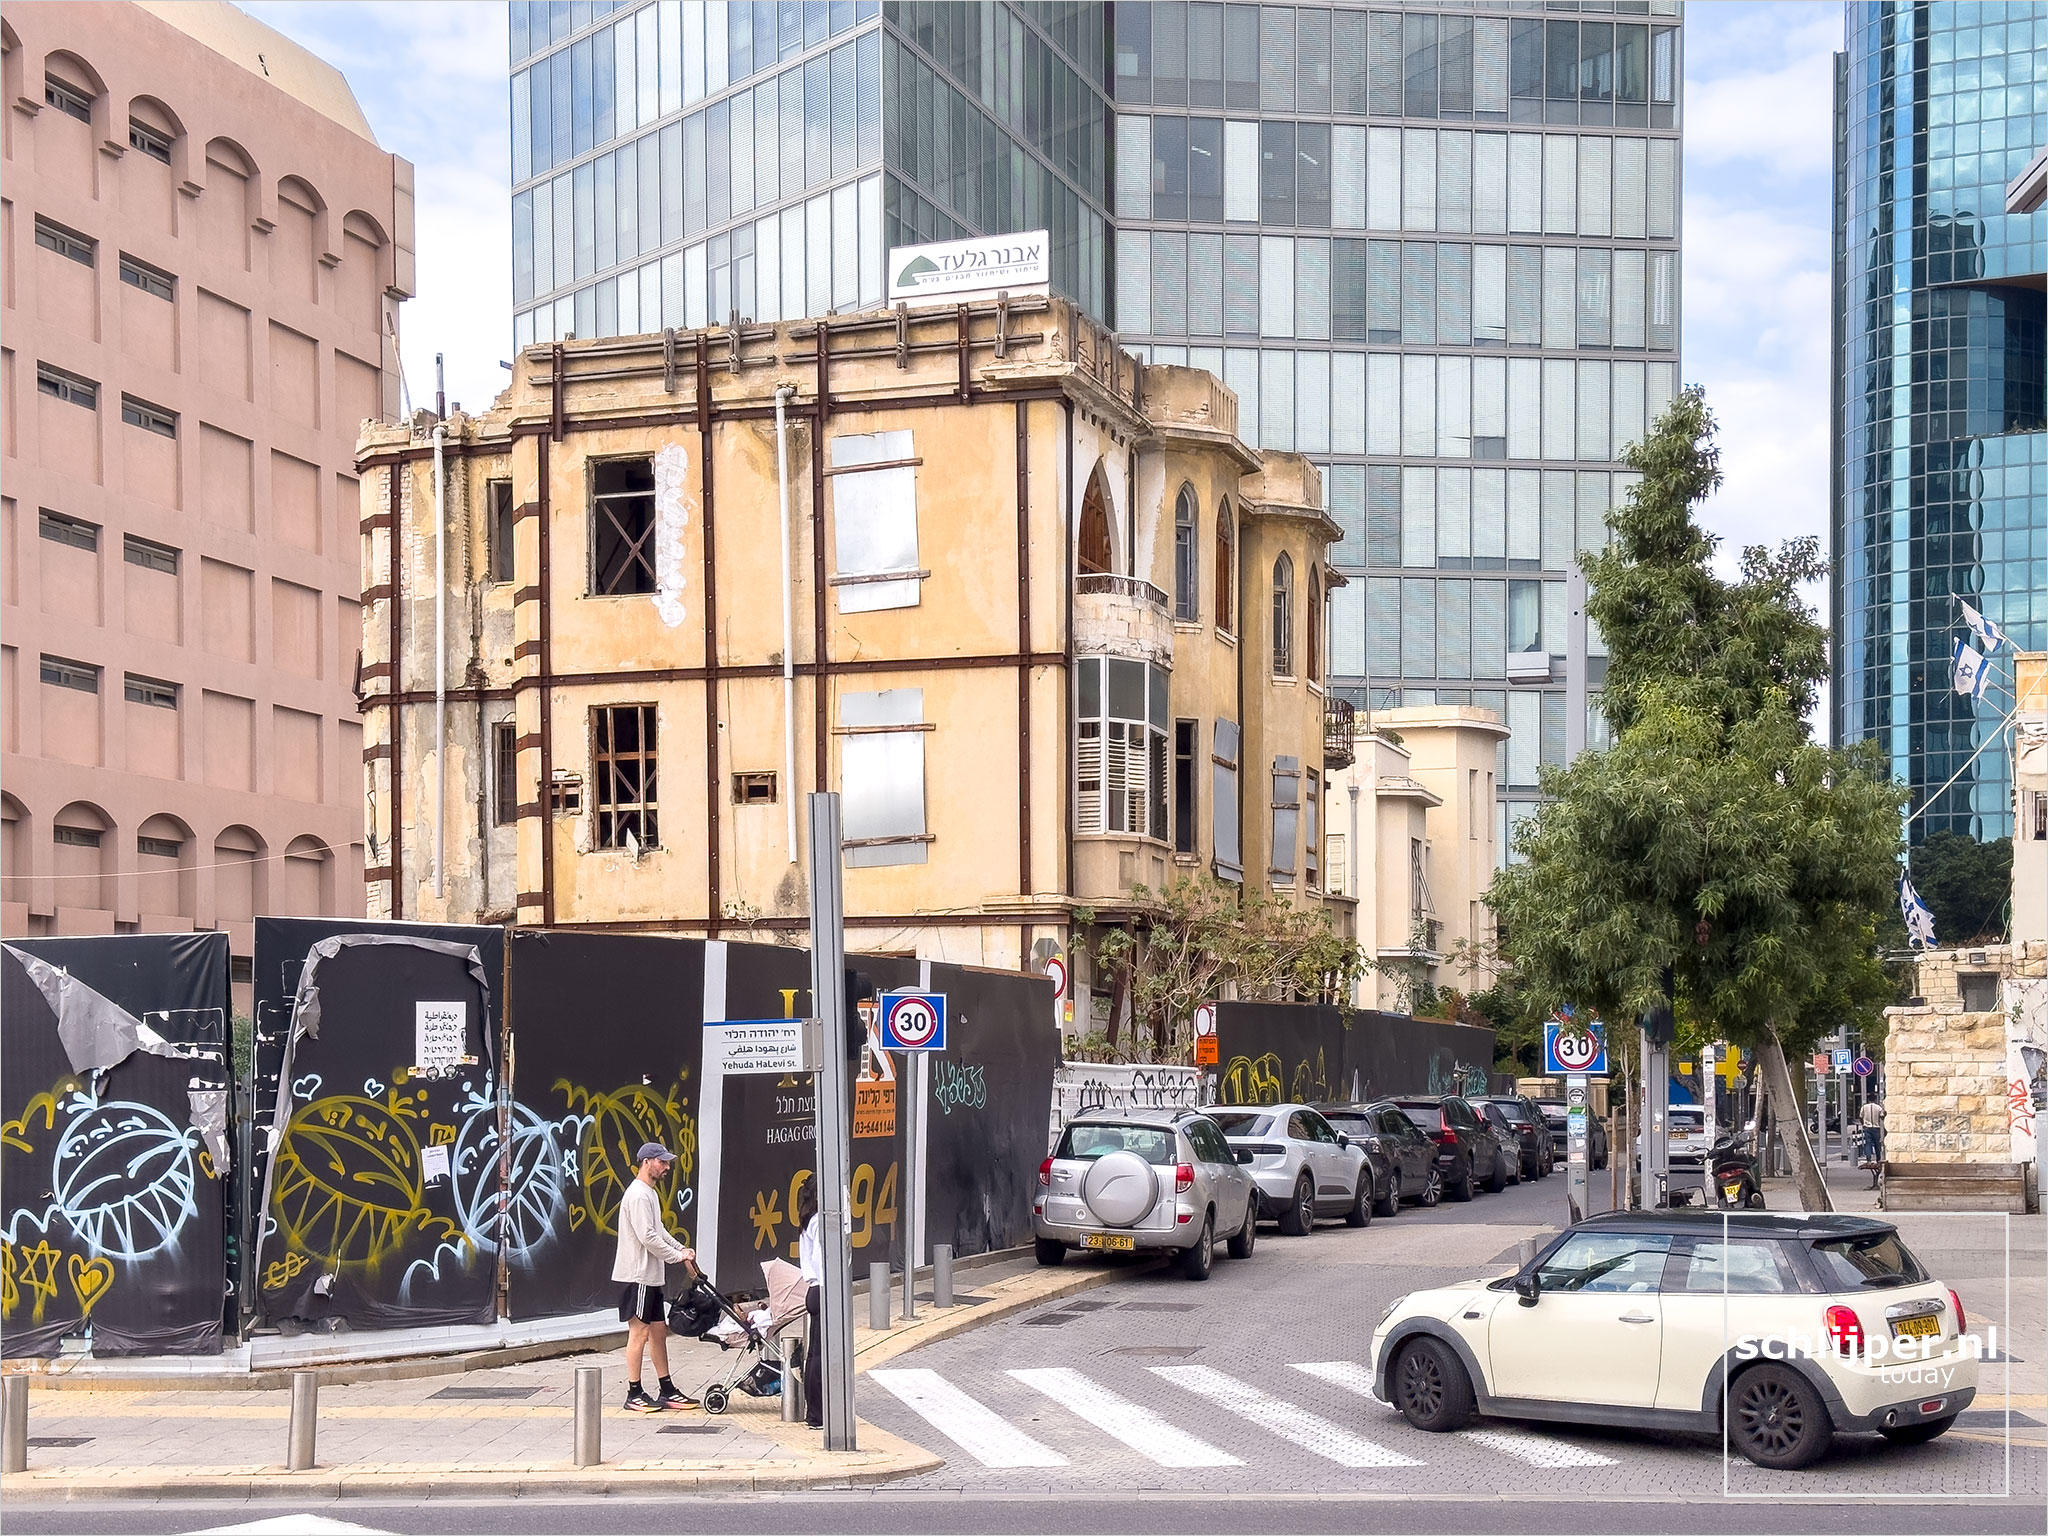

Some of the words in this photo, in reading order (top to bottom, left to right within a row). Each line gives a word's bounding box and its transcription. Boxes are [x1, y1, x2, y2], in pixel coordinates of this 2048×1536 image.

[938, 250, 987, 271] גלעד
[990, 245, 1040, 265] אבנר
[900, 1012, 927, 1032] 30
[724, 1029, 747, 1039] הלוי
[749, 1029, 779, 1038] יהודה
[780, 1044, 797, 1054] شارع
[1562, 1037, 1590, 1057] 30
[722, 1060, 754, 1070] Yehuda
[756, 1059, 786, 1068] HaLevi
[787, 1060, 797, 1068] St.
[766, 1125, 801, 1144] HAGAG
